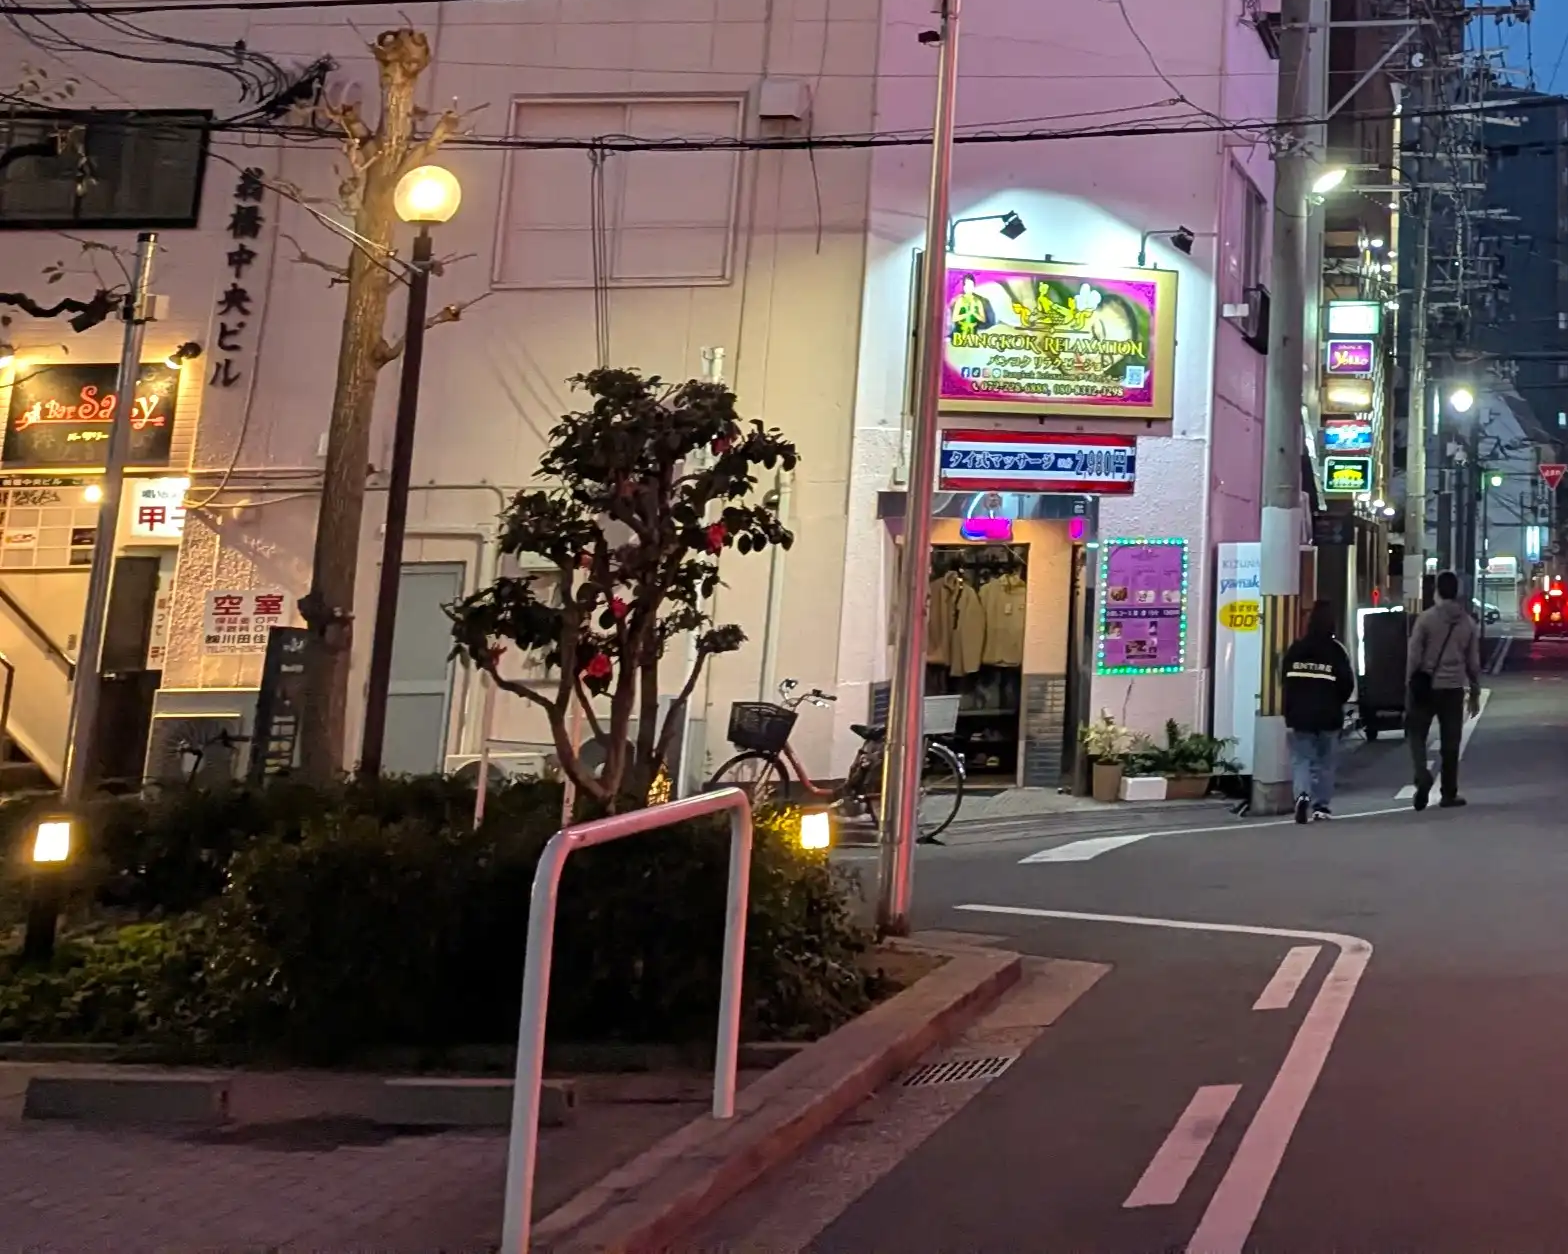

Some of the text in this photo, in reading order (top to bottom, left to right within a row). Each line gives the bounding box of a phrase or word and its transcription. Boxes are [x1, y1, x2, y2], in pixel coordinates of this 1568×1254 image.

[952, 332, 1146, 359] BANGKOK RELAXATION
[45, 385, 160, 430] Bar Say
[949, 449, 1055, 471] タイ式マッサージ
[211, 593, 285, 616] 空室
